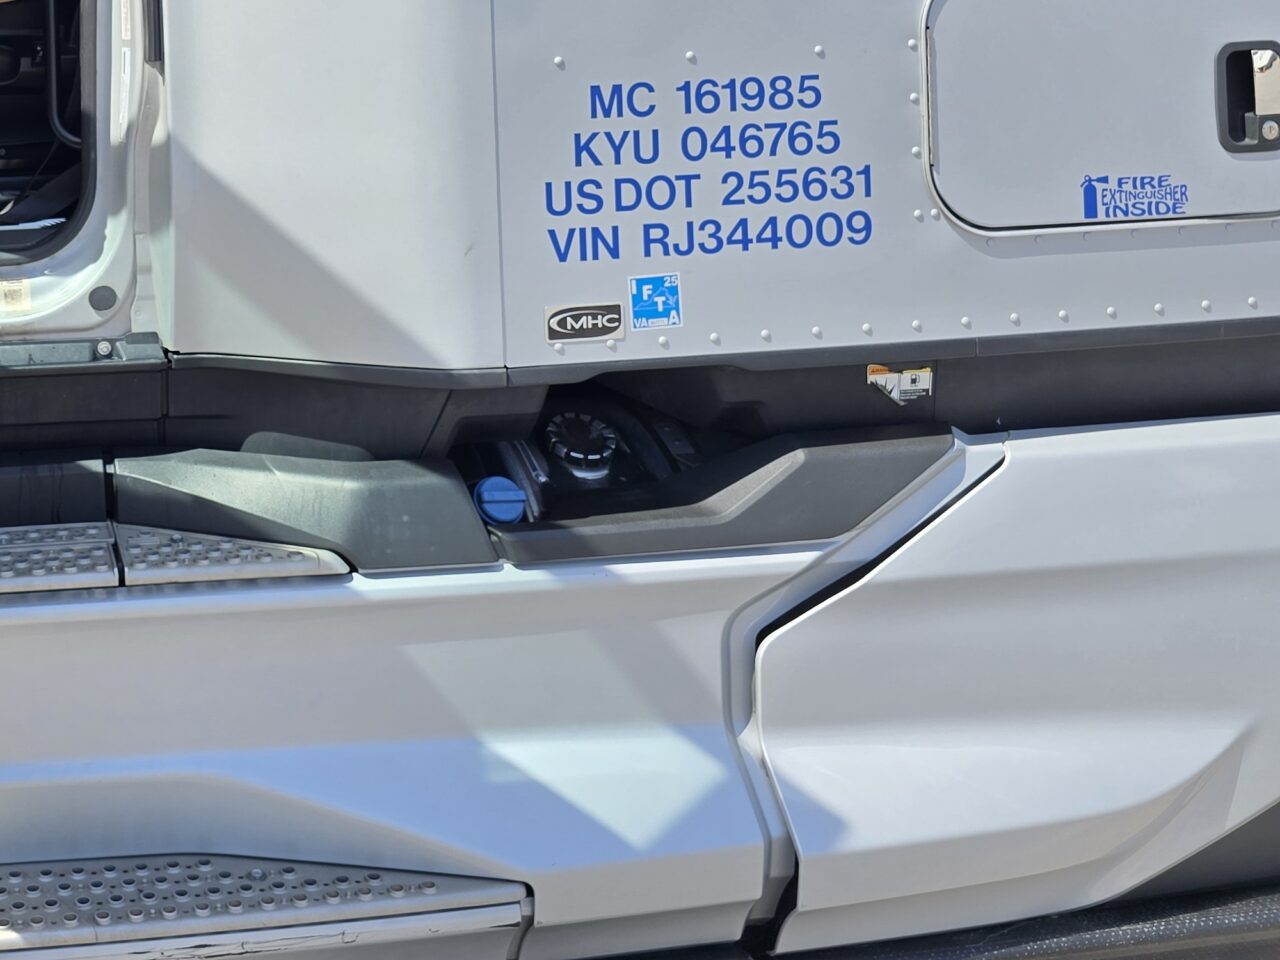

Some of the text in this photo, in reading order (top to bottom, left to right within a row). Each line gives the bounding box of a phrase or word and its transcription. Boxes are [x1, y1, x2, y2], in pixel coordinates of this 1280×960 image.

[589, 74, 822, 119] MC 161985
[573, 119, 842, 167] KYU 046765
[721, 164, 873, 206] 255631
[1117, 174, 1172, 190] FIRE
[1101, 184, 1189, 206] EXTINGUISHER
[1105, 201, 1186, 218] INSIDE
[547, 210, 873, 263] VIN RJ344009
[663, 276, 678, 288] 25
[566, 314, 620, 330] MHC
[633, 317, 648, 328] VA
